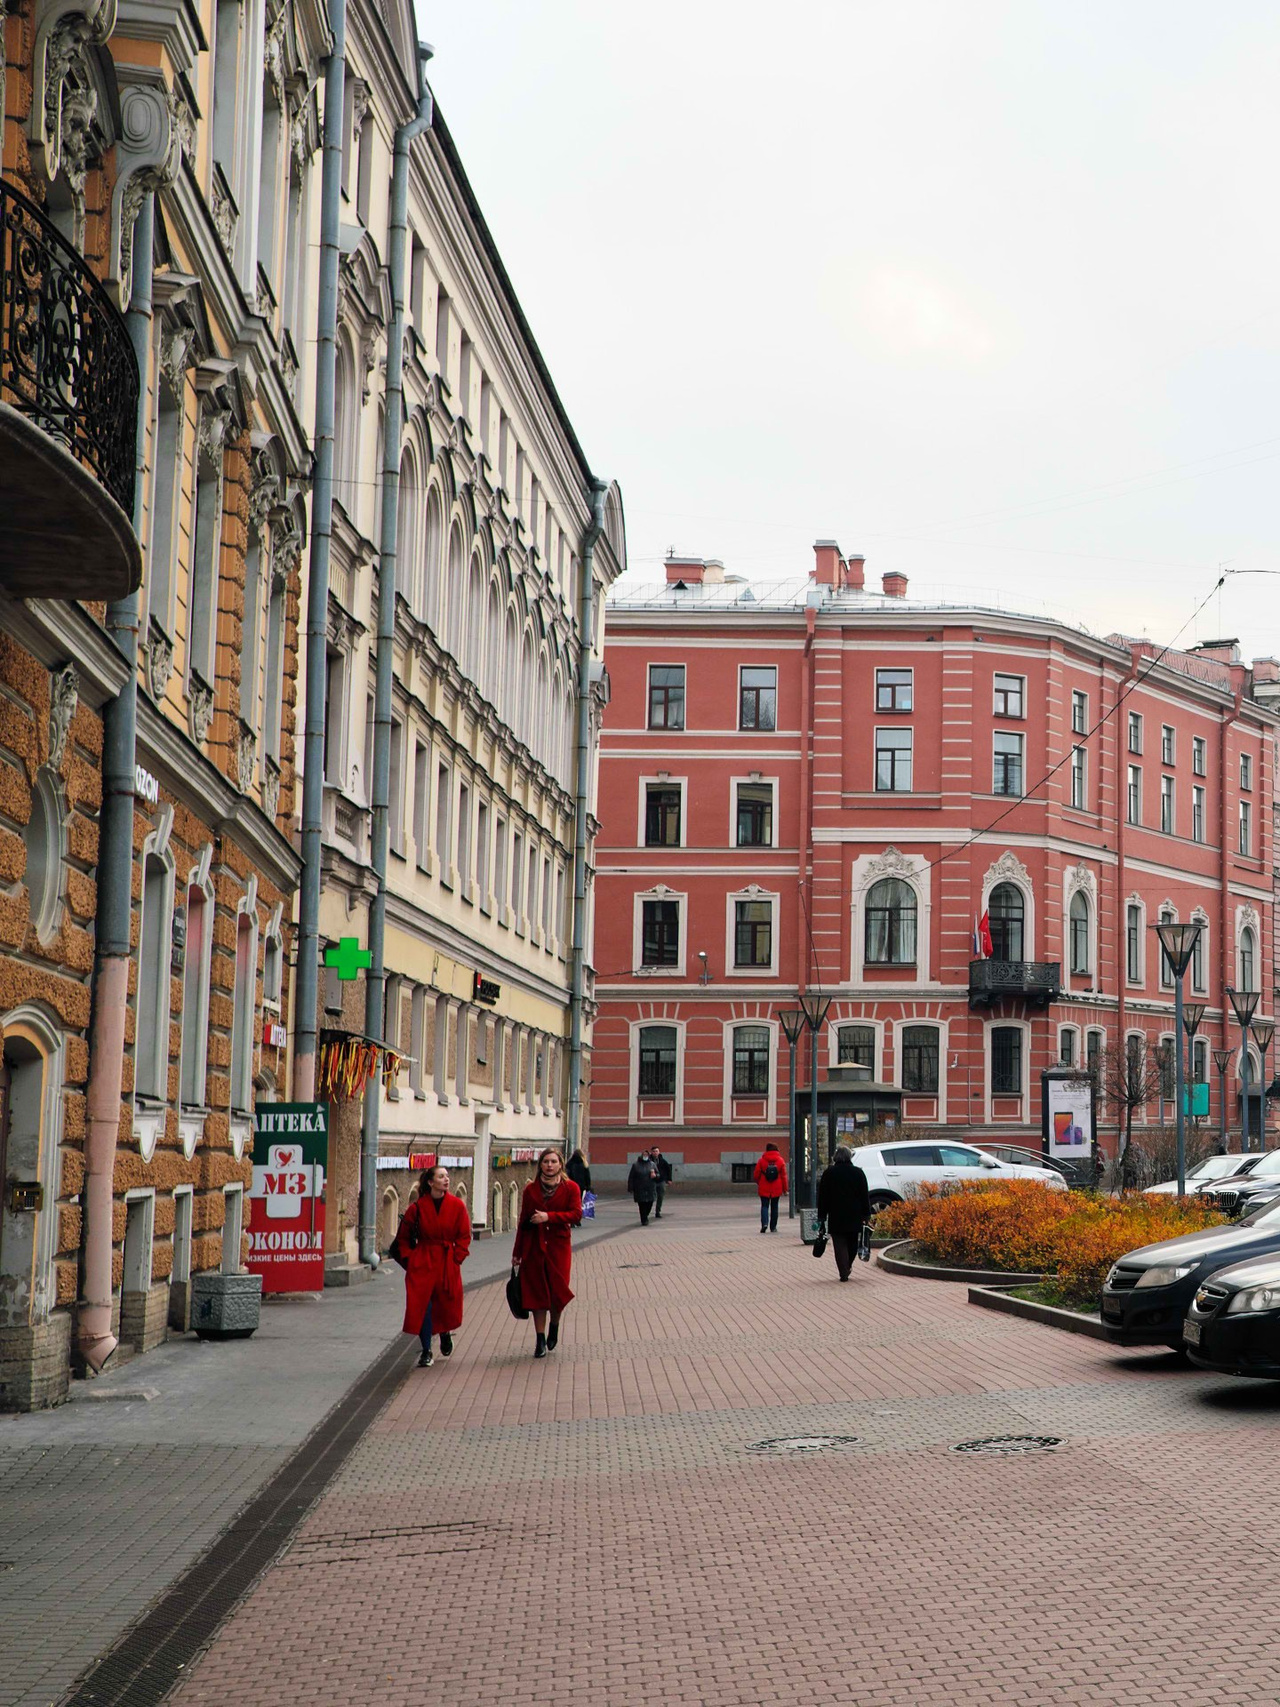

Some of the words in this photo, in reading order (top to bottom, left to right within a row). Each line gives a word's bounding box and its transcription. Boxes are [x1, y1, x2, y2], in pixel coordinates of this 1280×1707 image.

[135, 764, 159, 804] OZON
[247, 1254, 272, 1262] ИЗКИЕ
[273, 1254, 296, 1263] ЦЕНЫ
[297, 1253, 322, 1262] ЗДЕСЬ
